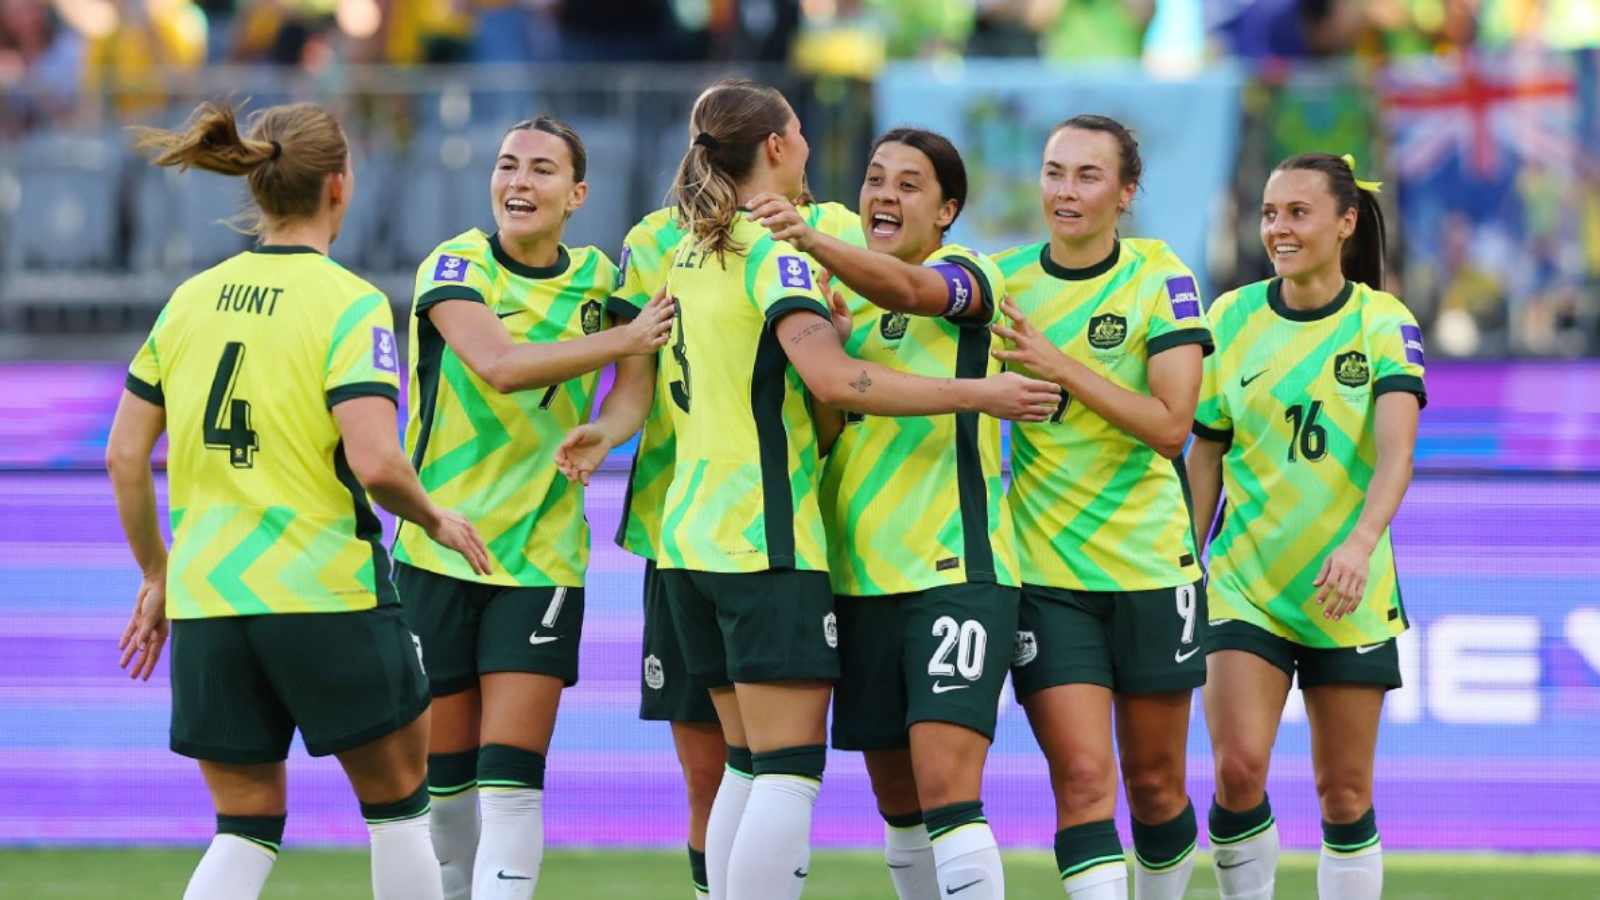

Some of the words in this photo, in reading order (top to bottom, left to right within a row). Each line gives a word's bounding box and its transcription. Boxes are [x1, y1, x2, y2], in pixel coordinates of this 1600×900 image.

[216, 283, 284, 317] HUNT
[203, 341, 259, 469] 4
[1284, 399, 1328, 463] 16
[1175, 583, 1196, 644] 9
[928, 615, 987, 681] 20
